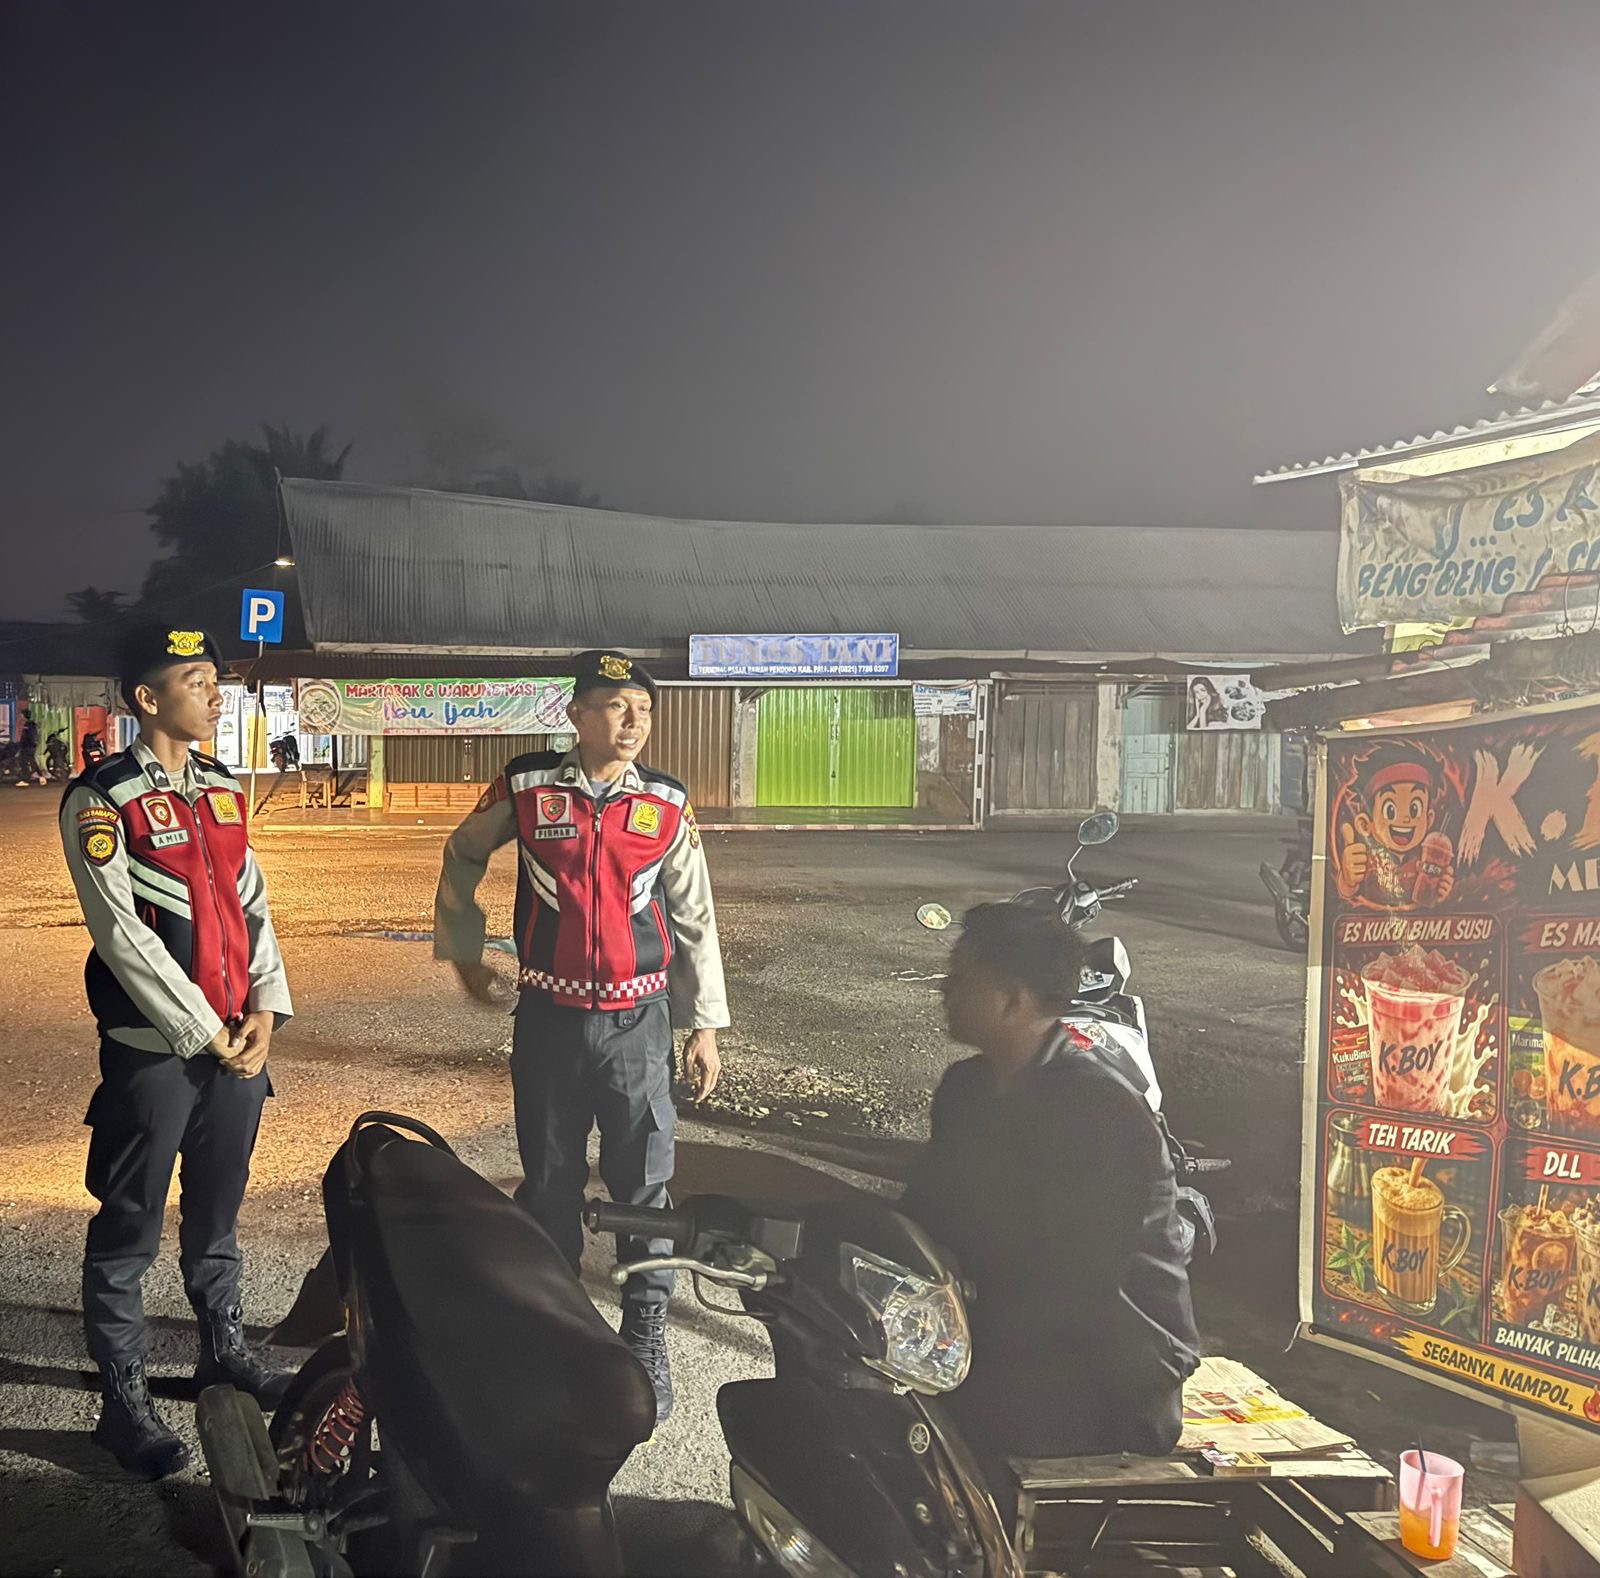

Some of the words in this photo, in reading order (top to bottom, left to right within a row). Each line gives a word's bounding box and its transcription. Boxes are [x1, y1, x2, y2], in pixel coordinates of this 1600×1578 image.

[249, 598, 276, 633] P
[815, 639, 893, 663] TANI
[346, 683, 420, 698] MARTABAK
[424, 683, 434, 698] &
[1343, 922, 1362, 943] ES
[1363, 919, 1407, 943] KUKU
[1408, 919, 1452, 941] BIMA
[1453, 919, 1493, 941] SUSU
[1540, 921, 1569, 948] ES
[1379, 1039, 1444, 1077] K.BOY
[1368, 1123, 1397, 1148] TEH
[1401, 1127, 1456, 1154] TARIK
[1543, 1151, 1582, 1178] DLL
[1382, 1239, 1429, 1274] K.BOY
[1508, 1263, 1563, 1291] K.BOY
[1495, 1327, 1554, 1357] BANYAK
[1422, 1341, 1495, 1382] SEGARNYA
[1500, 1368, 1573, 1412] NAMPOL,
